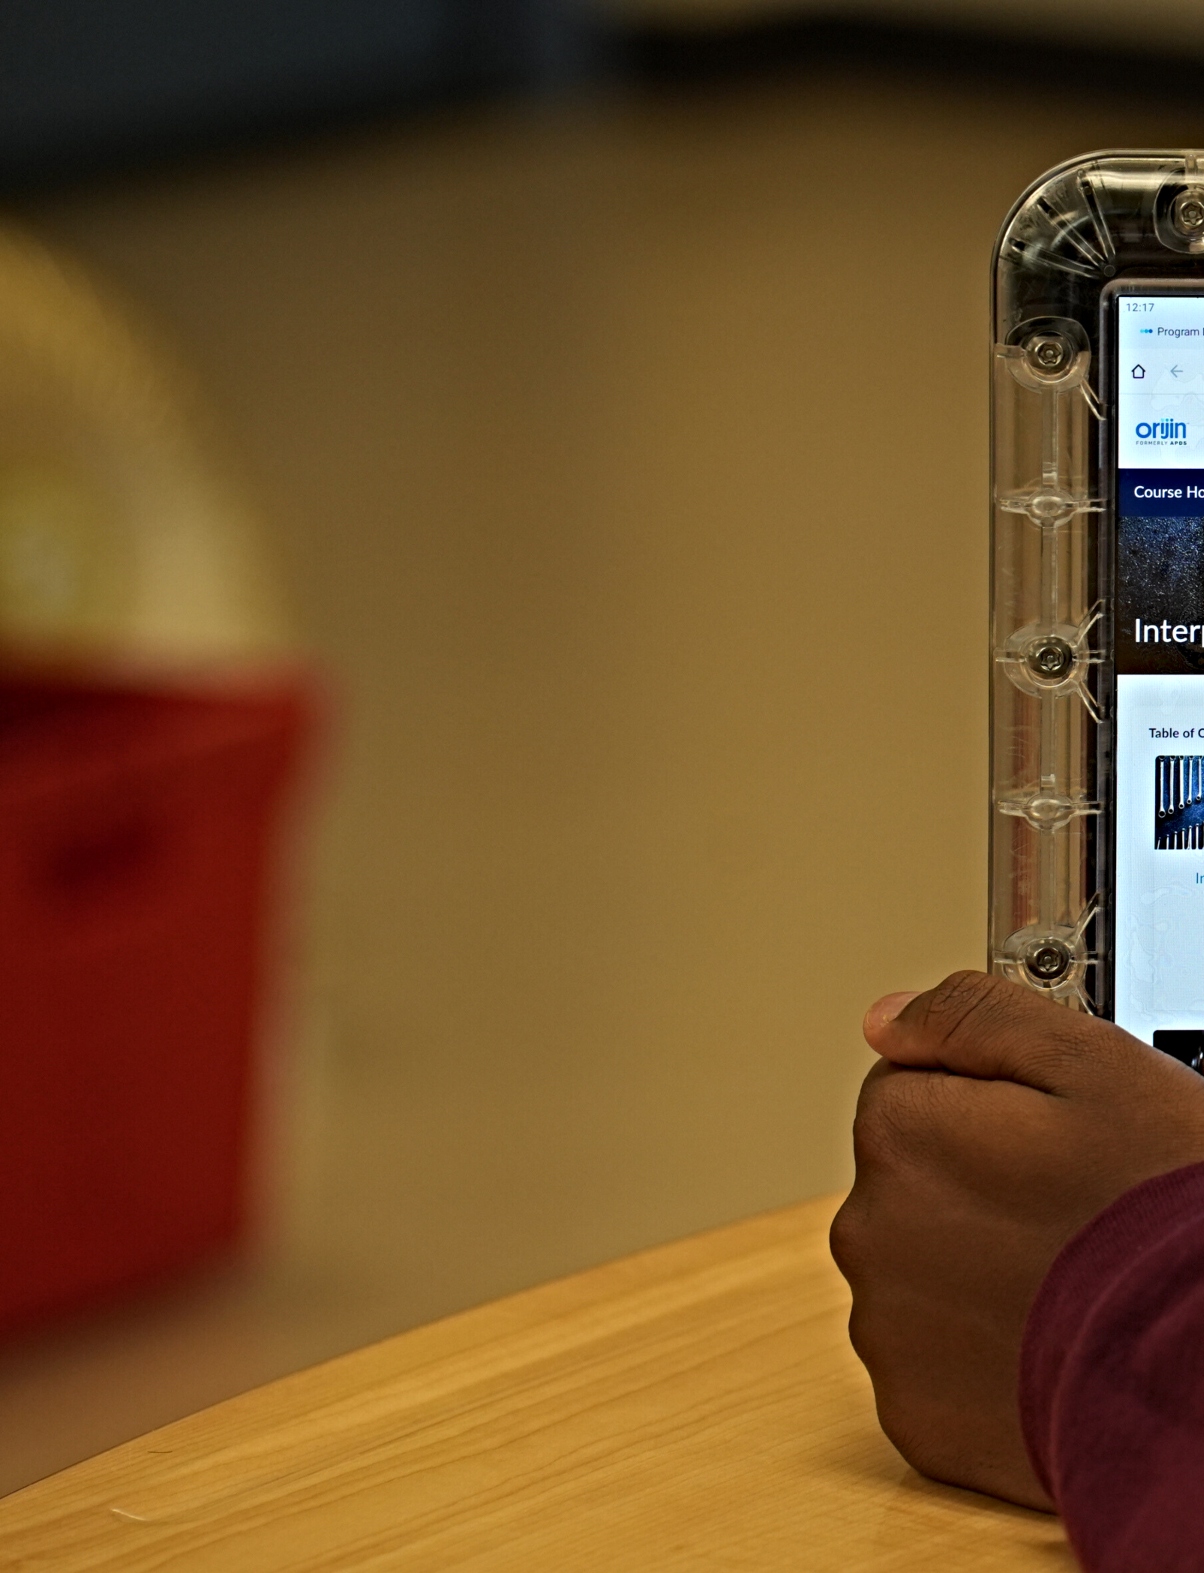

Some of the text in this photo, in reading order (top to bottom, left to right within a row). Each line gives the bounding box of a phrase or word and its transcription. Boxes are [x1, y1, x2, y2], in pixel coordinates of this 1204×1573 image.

[1126, 302, 1155, 313] 12:17
[1157, 326, 1200, 339] Program
[1133, 485, 1183, 499] Course
[1148, 727, 1180, 739] Table
[1182, 727, 1195, 739] of
